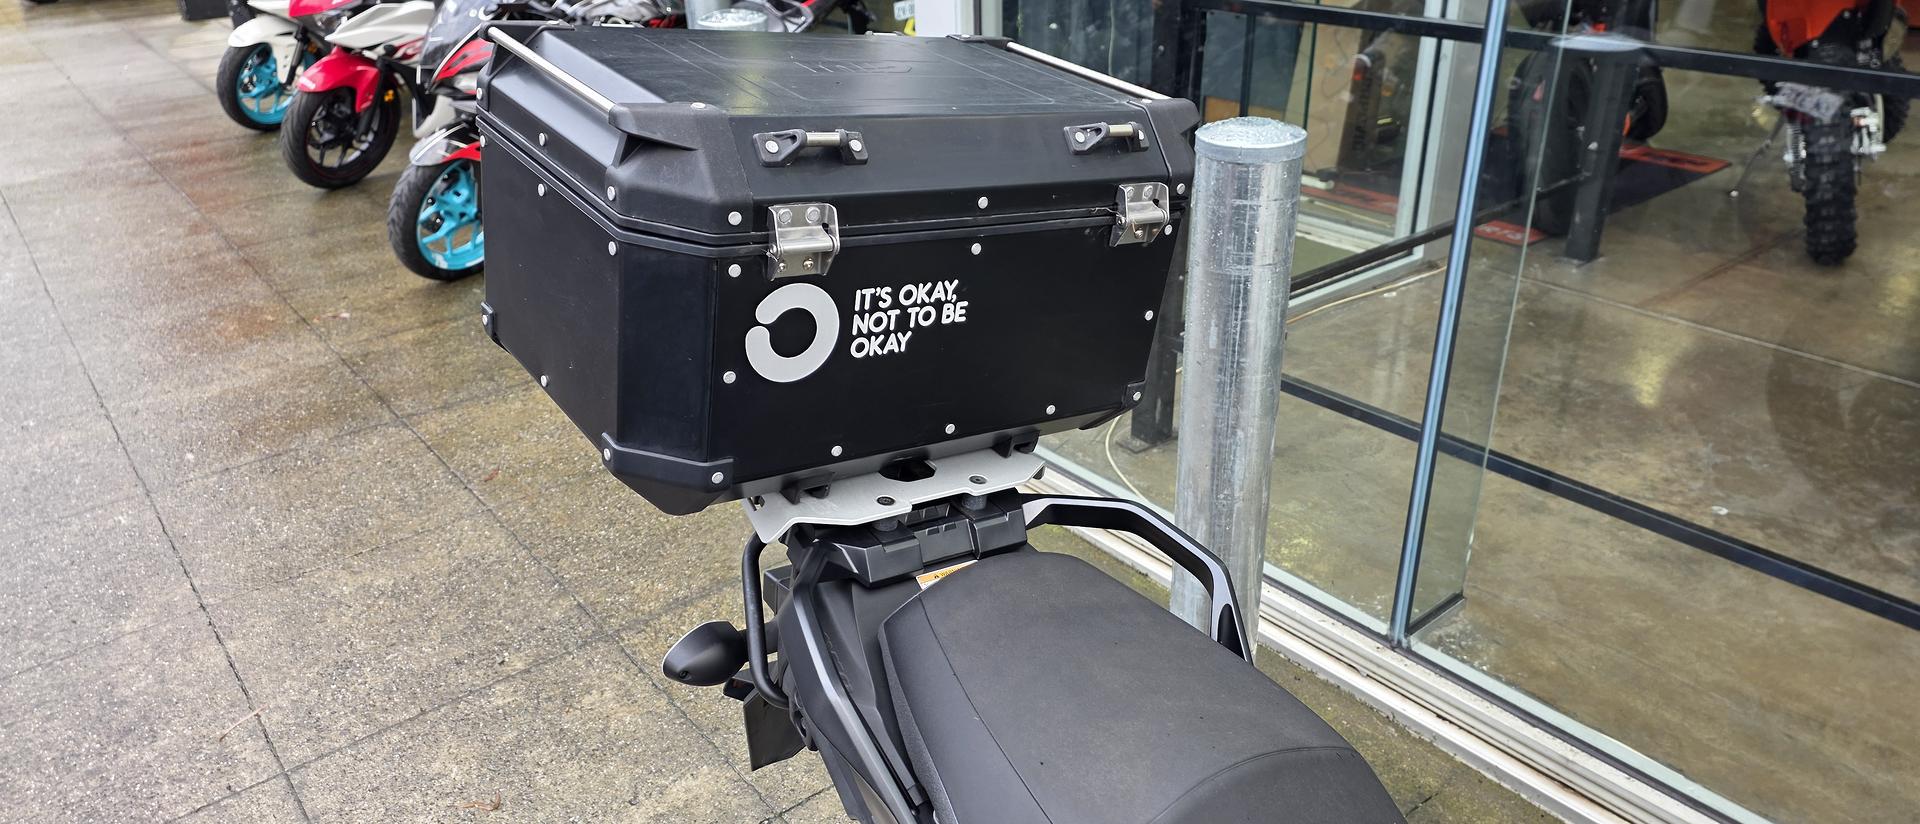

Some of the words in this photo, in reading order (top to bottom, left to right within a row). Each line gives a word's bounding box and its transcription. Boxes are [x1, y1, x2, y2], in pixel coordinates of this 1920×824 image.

[854, 287, 892, 311] IT'S
[898, 279, 959, 306] OKAY,
[852, 309, 901, 336] NOT
[907, 305, 937, 329] TO
[941, 301, 969, 325] BE
[849, 331, 912, 359] OKAY
